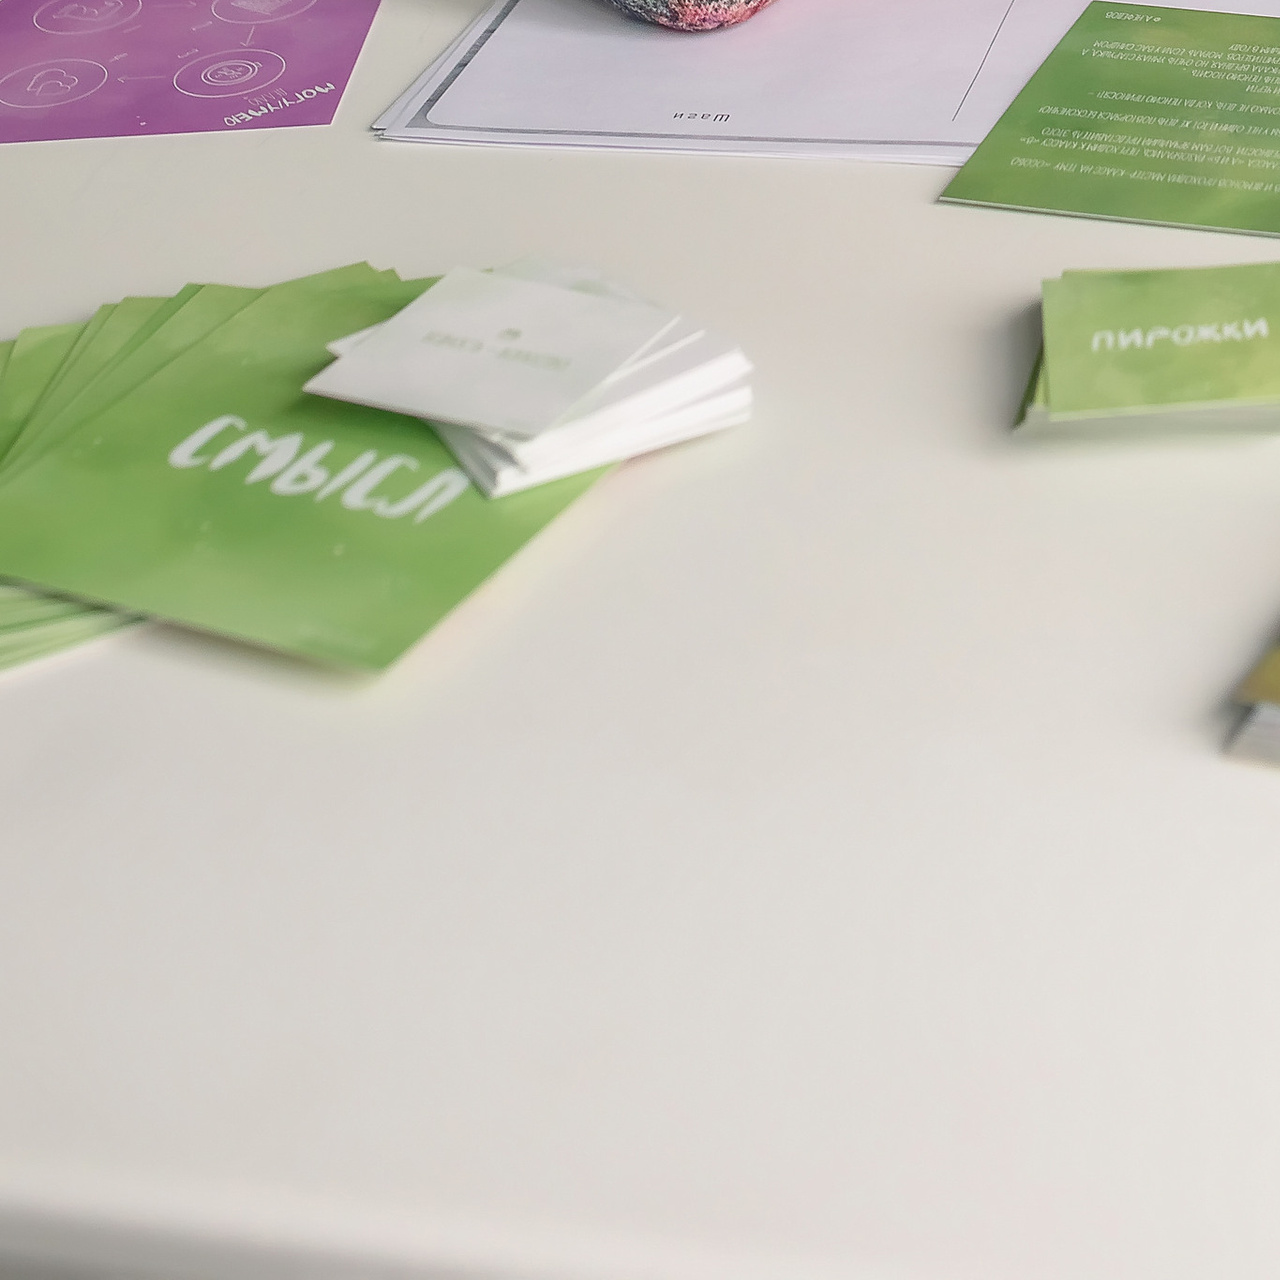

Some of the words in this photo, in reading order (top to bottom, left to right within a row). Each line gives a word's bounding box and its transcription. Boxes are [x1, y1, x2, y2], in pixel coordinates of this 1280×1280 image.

[1133, 43, 1155, 53] ВАС
[1193, 58, 1210, 67] НО
[1224, 72, 1262, 82] ПЕНСИЮ
[1038, 127, 1071, 138] ЭТОГО
[1091, 316, 1269, 352] ПИРОЖКИ
[168, 414, 470, 524] СМЫСЛ
